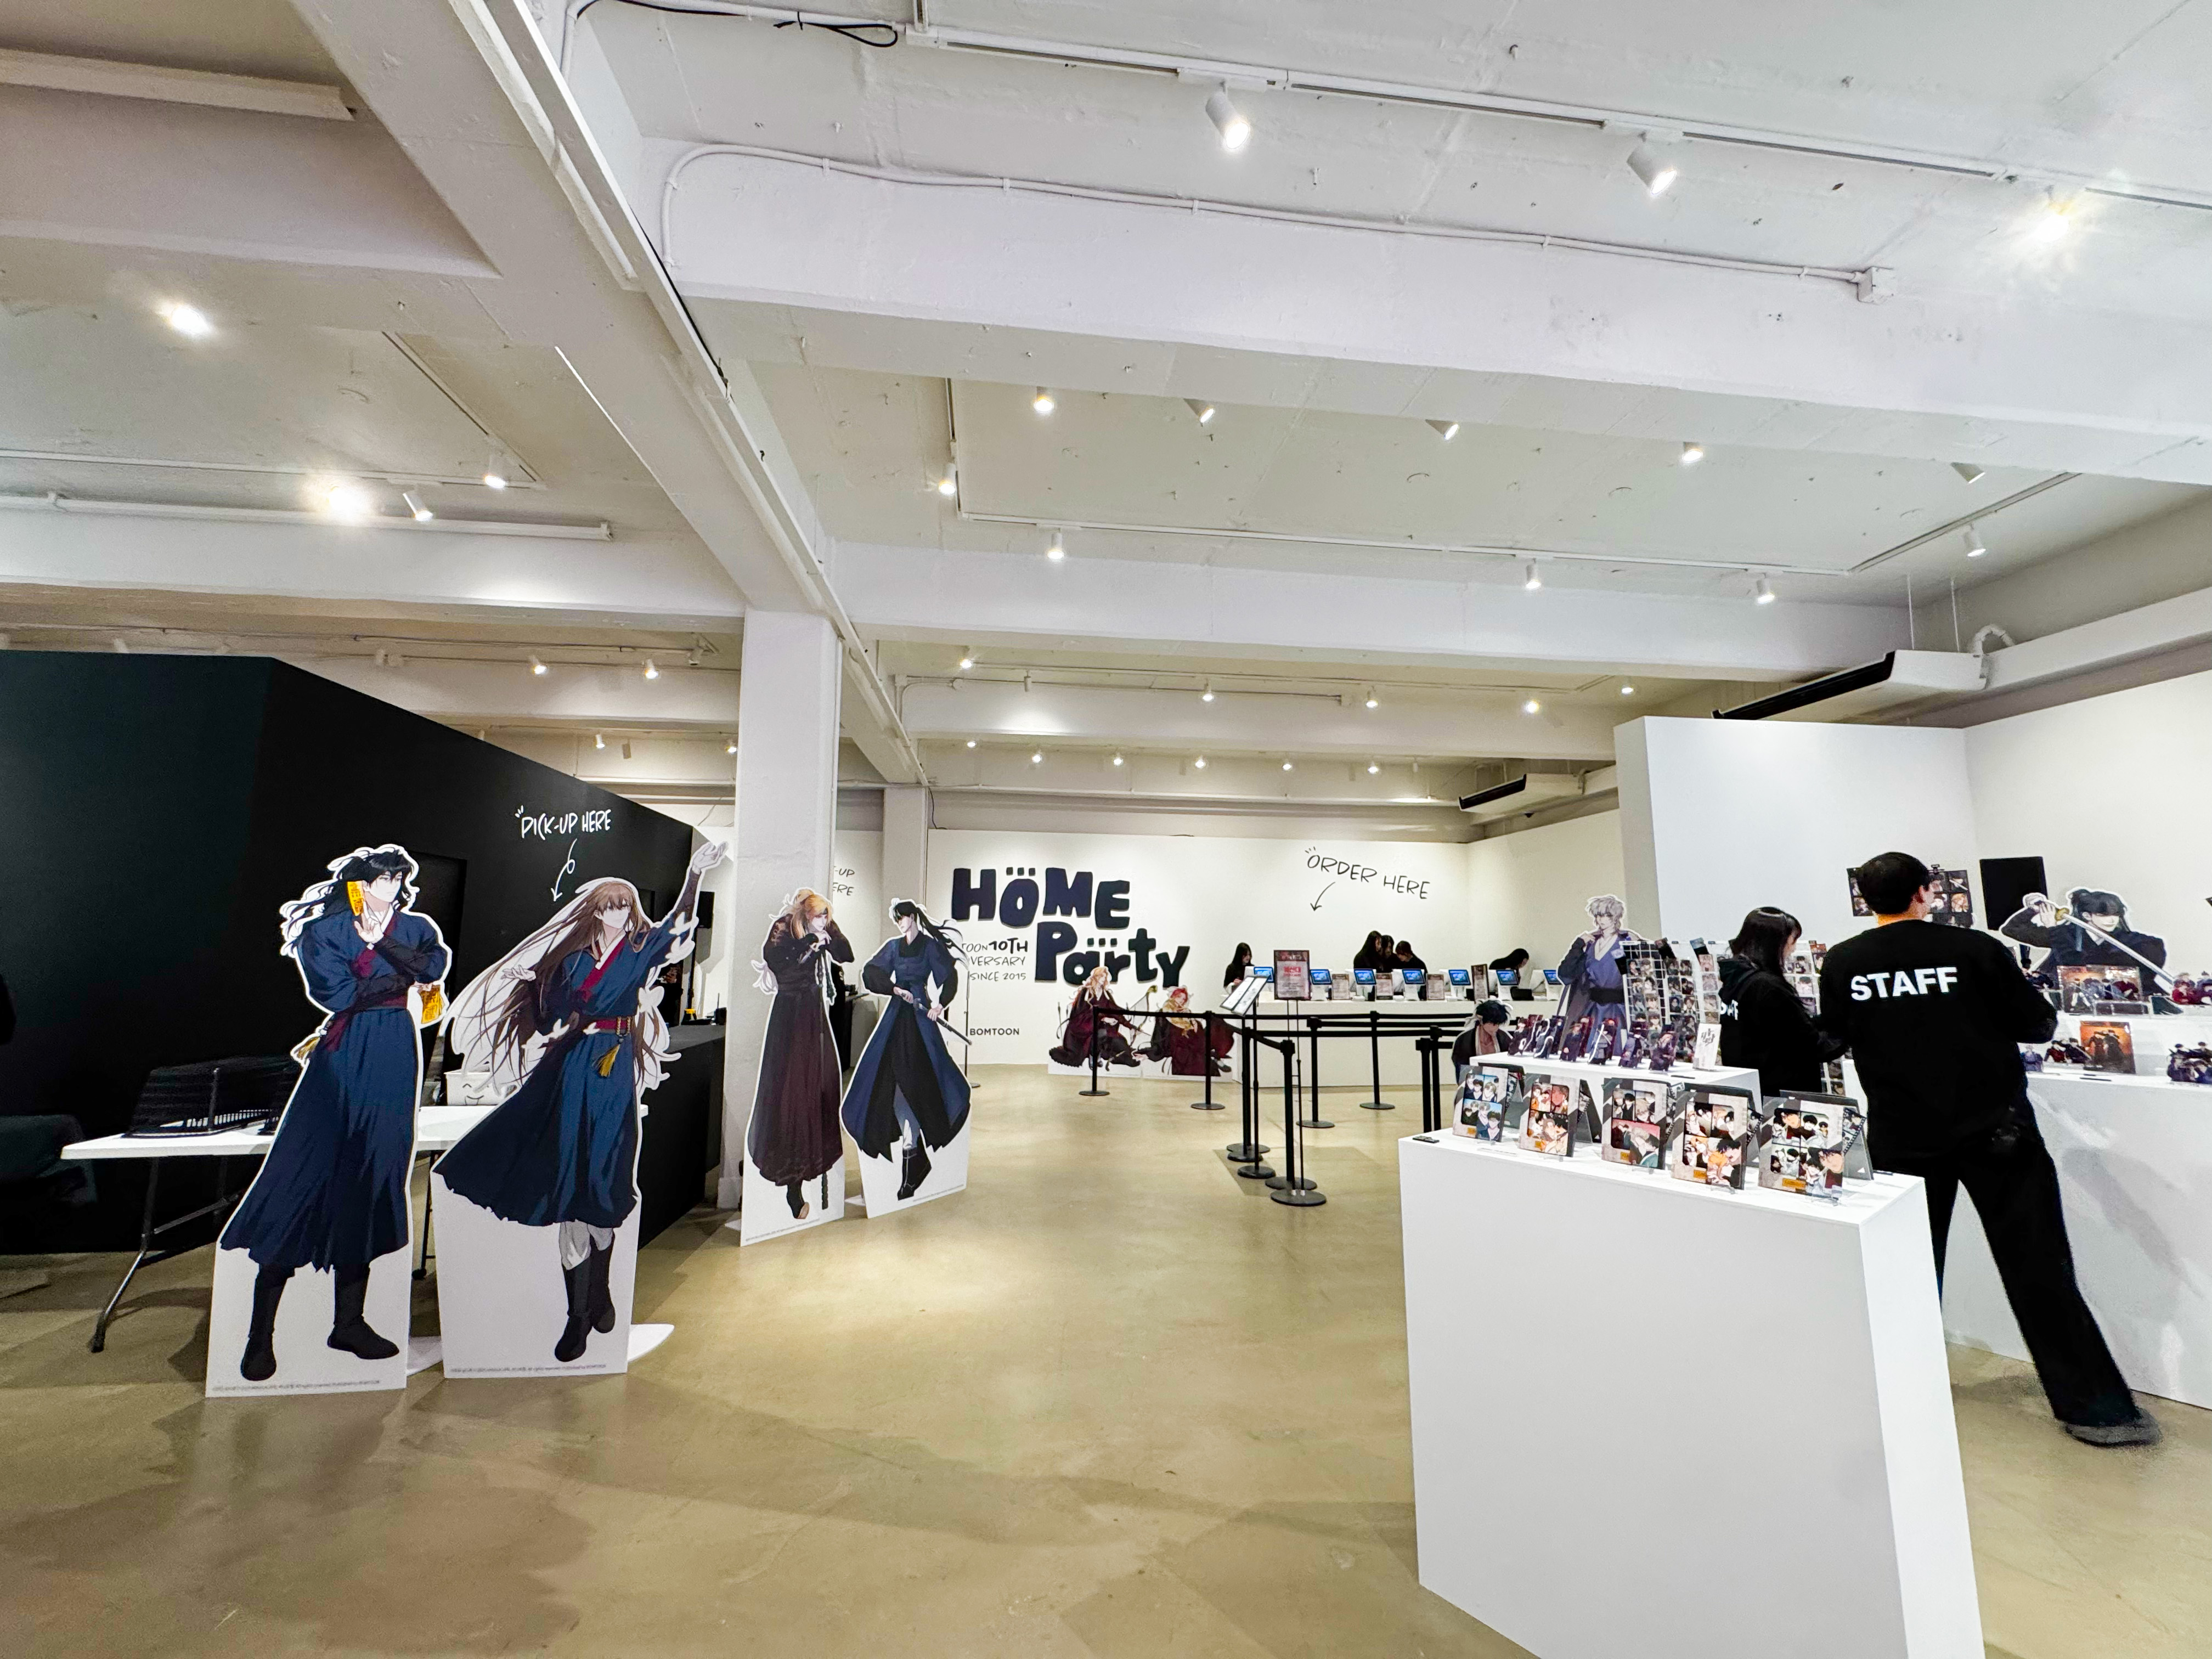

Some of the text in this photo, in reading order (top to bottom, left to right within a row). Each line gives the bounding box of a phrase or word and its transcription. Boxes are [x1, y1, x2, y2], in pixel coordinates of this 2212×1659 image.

[521, 809, 612, 840] PICK-UP HERE
[1307, 854, 1431, 899] ORDER HERE
[988, 937, 1028, 954] 10TH
[969, 971, 999, 981] SINCE
[1850, 966, 1959, 1001] STAFF
[969, 1028, 1019, 1036] BOMTOON
